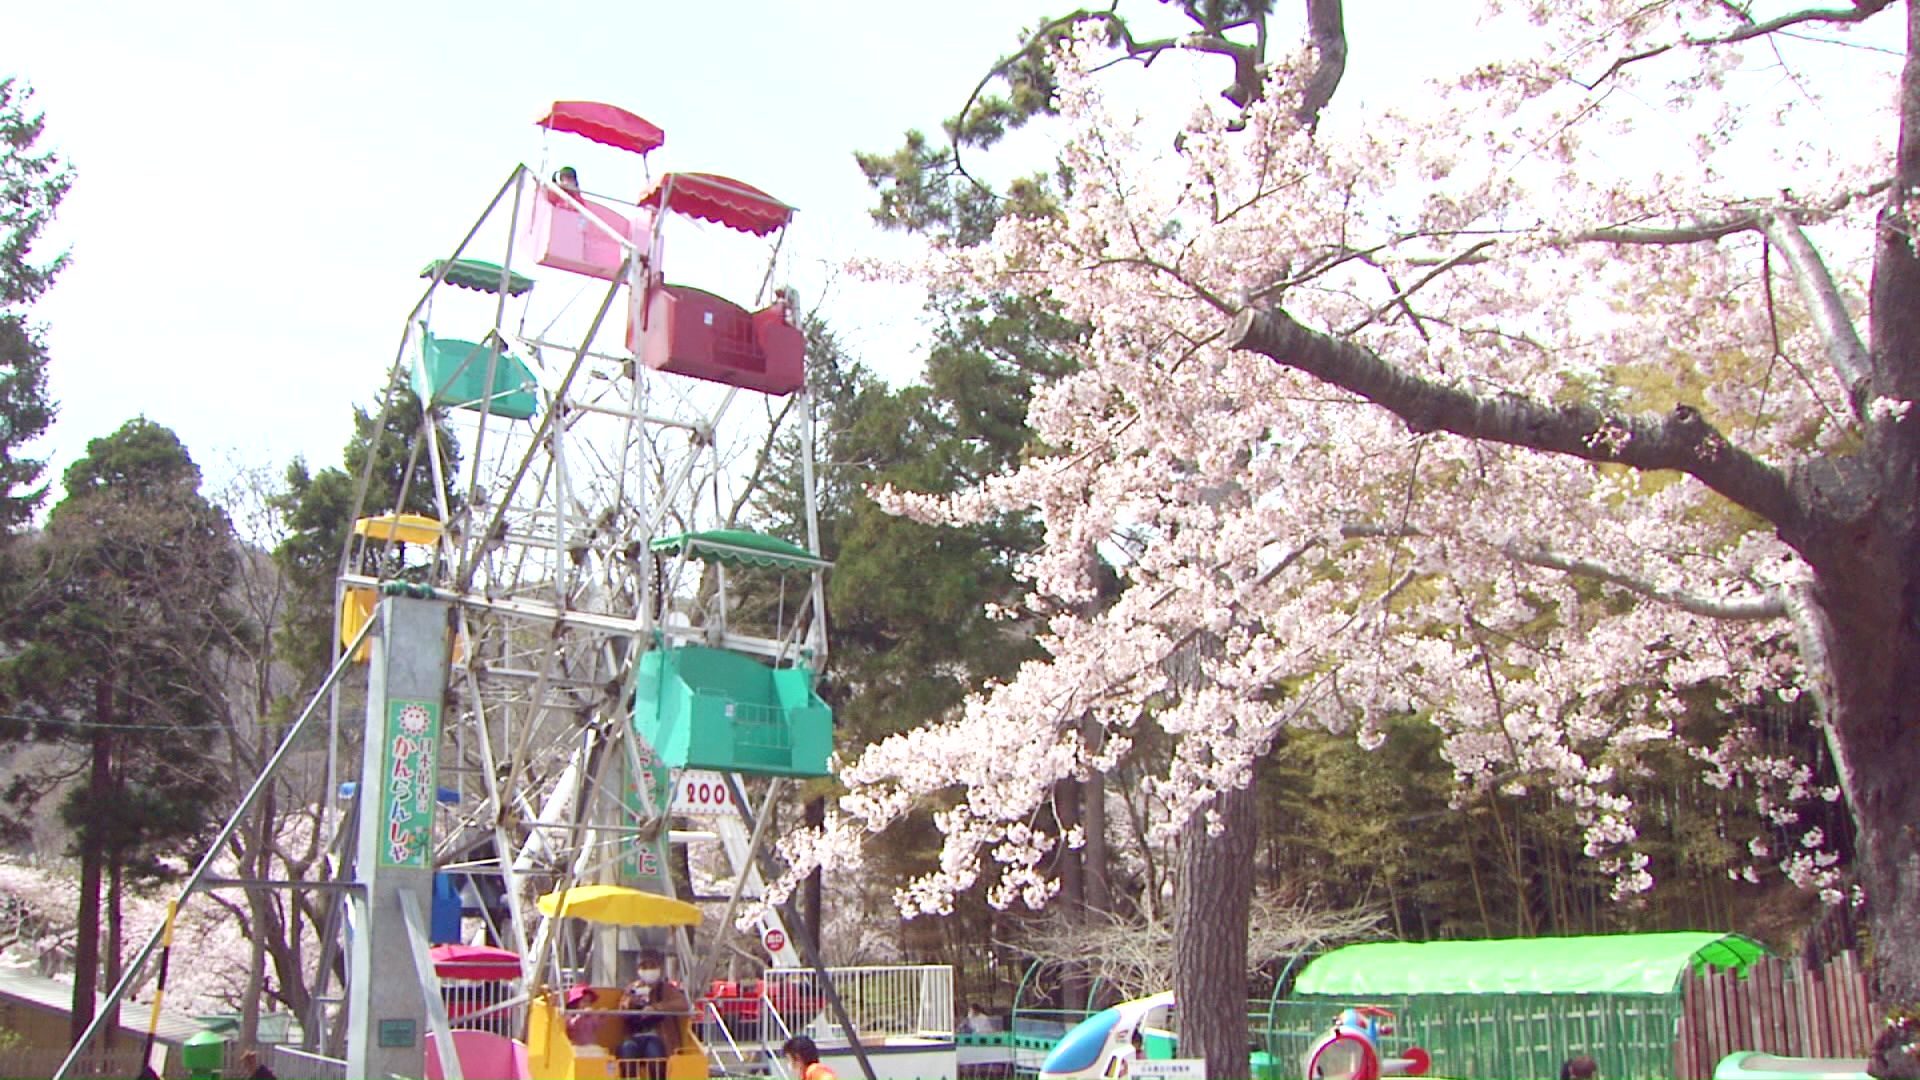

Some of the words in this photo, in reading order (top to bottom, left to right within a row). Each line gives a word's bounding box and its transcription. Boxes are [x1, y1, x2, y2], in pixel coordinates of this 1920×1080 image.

[390, 736, 415, 862] かんらんしゃ
